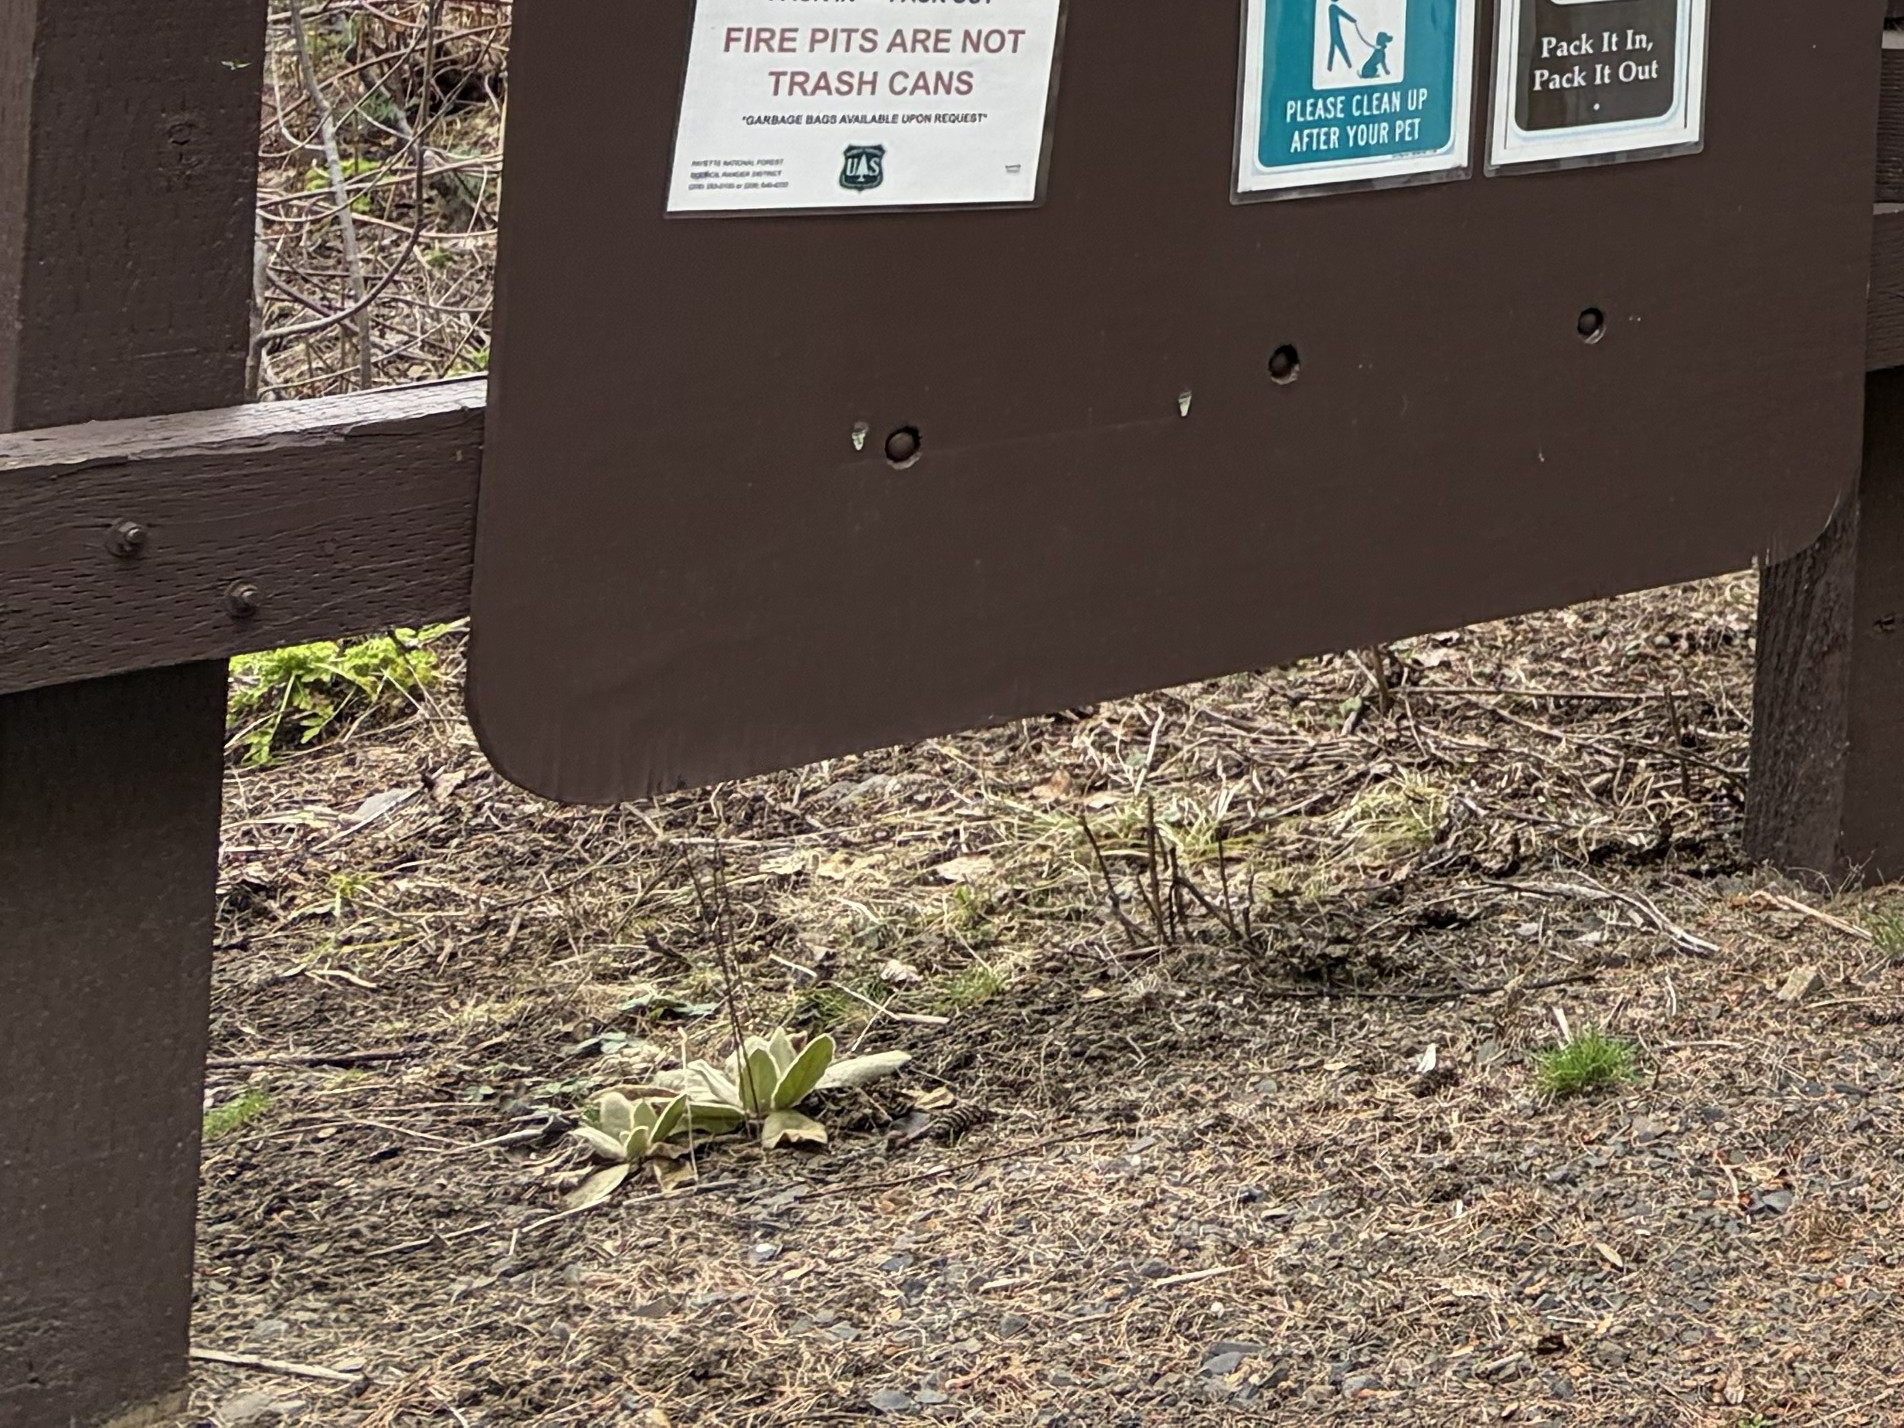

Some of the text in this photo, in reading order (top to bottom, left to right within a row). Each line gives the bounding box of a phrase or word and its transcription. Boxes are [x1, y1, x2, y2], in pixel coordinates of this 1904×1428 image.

[723, 27, 1025, 53] FIRE PITS ARE NOT
[1541, 29, 1652, 57] Pack It In,
[768, 70, 973, 95] TRASH CANS
[1533, 60, 1657, 90] Pack It Out
[805, 114, 836, 124] BAGS
[839, 114, 897, 123] AVAILABLE
[901, 113, 931, 123] UPON
[1286, 88, 1427, 122] PLEASE CLEAN UP
[1290, 120, 1420, 152] AFTER YOUR PET
